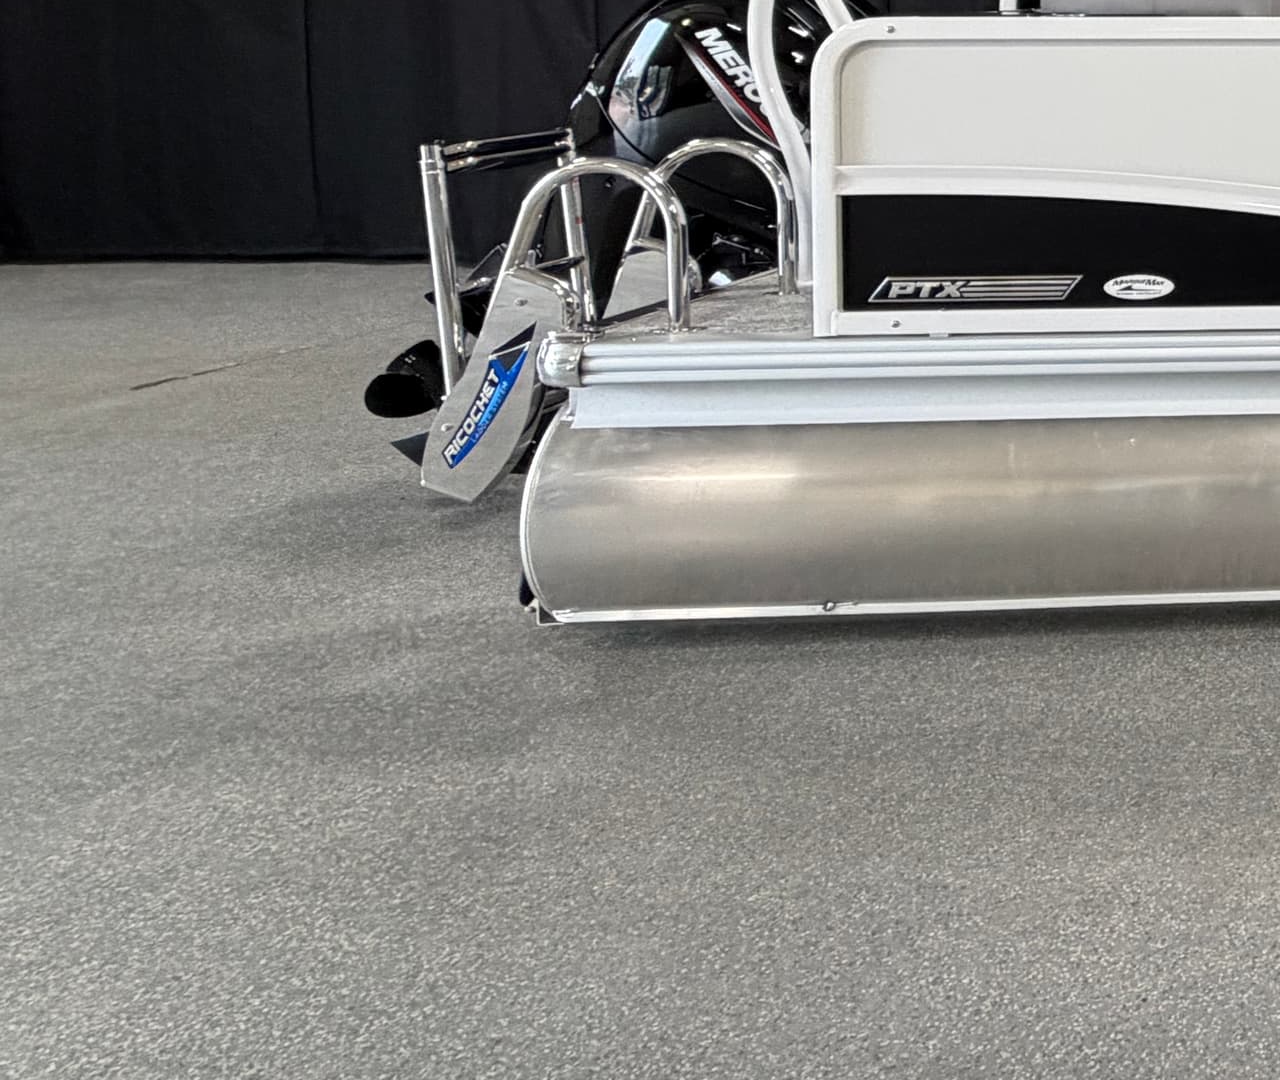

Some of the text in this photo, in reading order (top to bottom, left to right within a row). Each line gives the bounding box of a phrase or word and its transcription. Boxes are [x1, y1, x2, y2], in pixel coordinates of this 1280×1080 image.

[694, 27, 772, 120] MERC
[888, 281, 966, 298] PTX
[444, 368, 499, 465] RICOCHET
